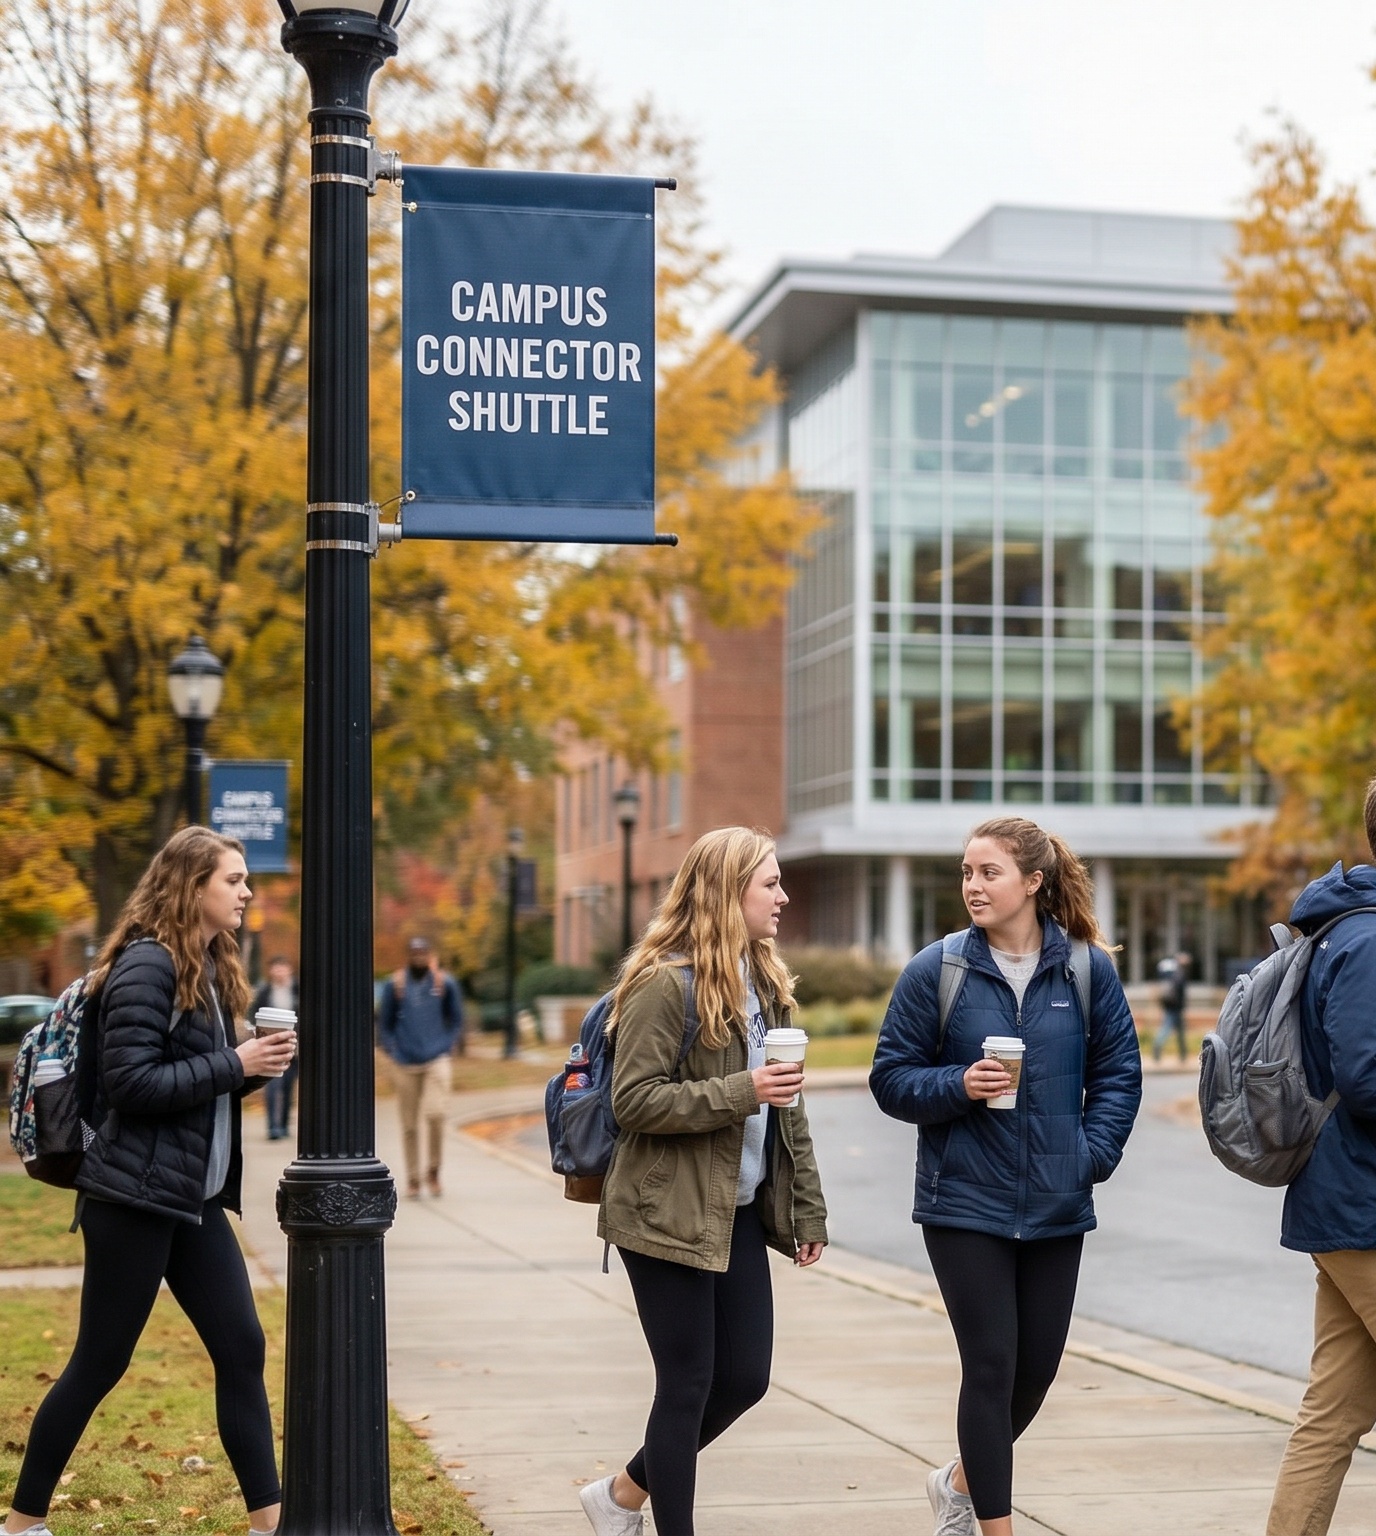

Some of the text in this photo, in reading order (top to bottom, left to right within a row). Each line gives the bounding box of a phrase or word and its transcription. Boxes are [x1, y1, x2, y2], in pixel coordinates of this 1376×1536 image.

[451, 280, 608, 327] CAMPUS
[416, 334, 642, 382] CONNECTOR
[448, 390, 609, 435] SHUTTLE
